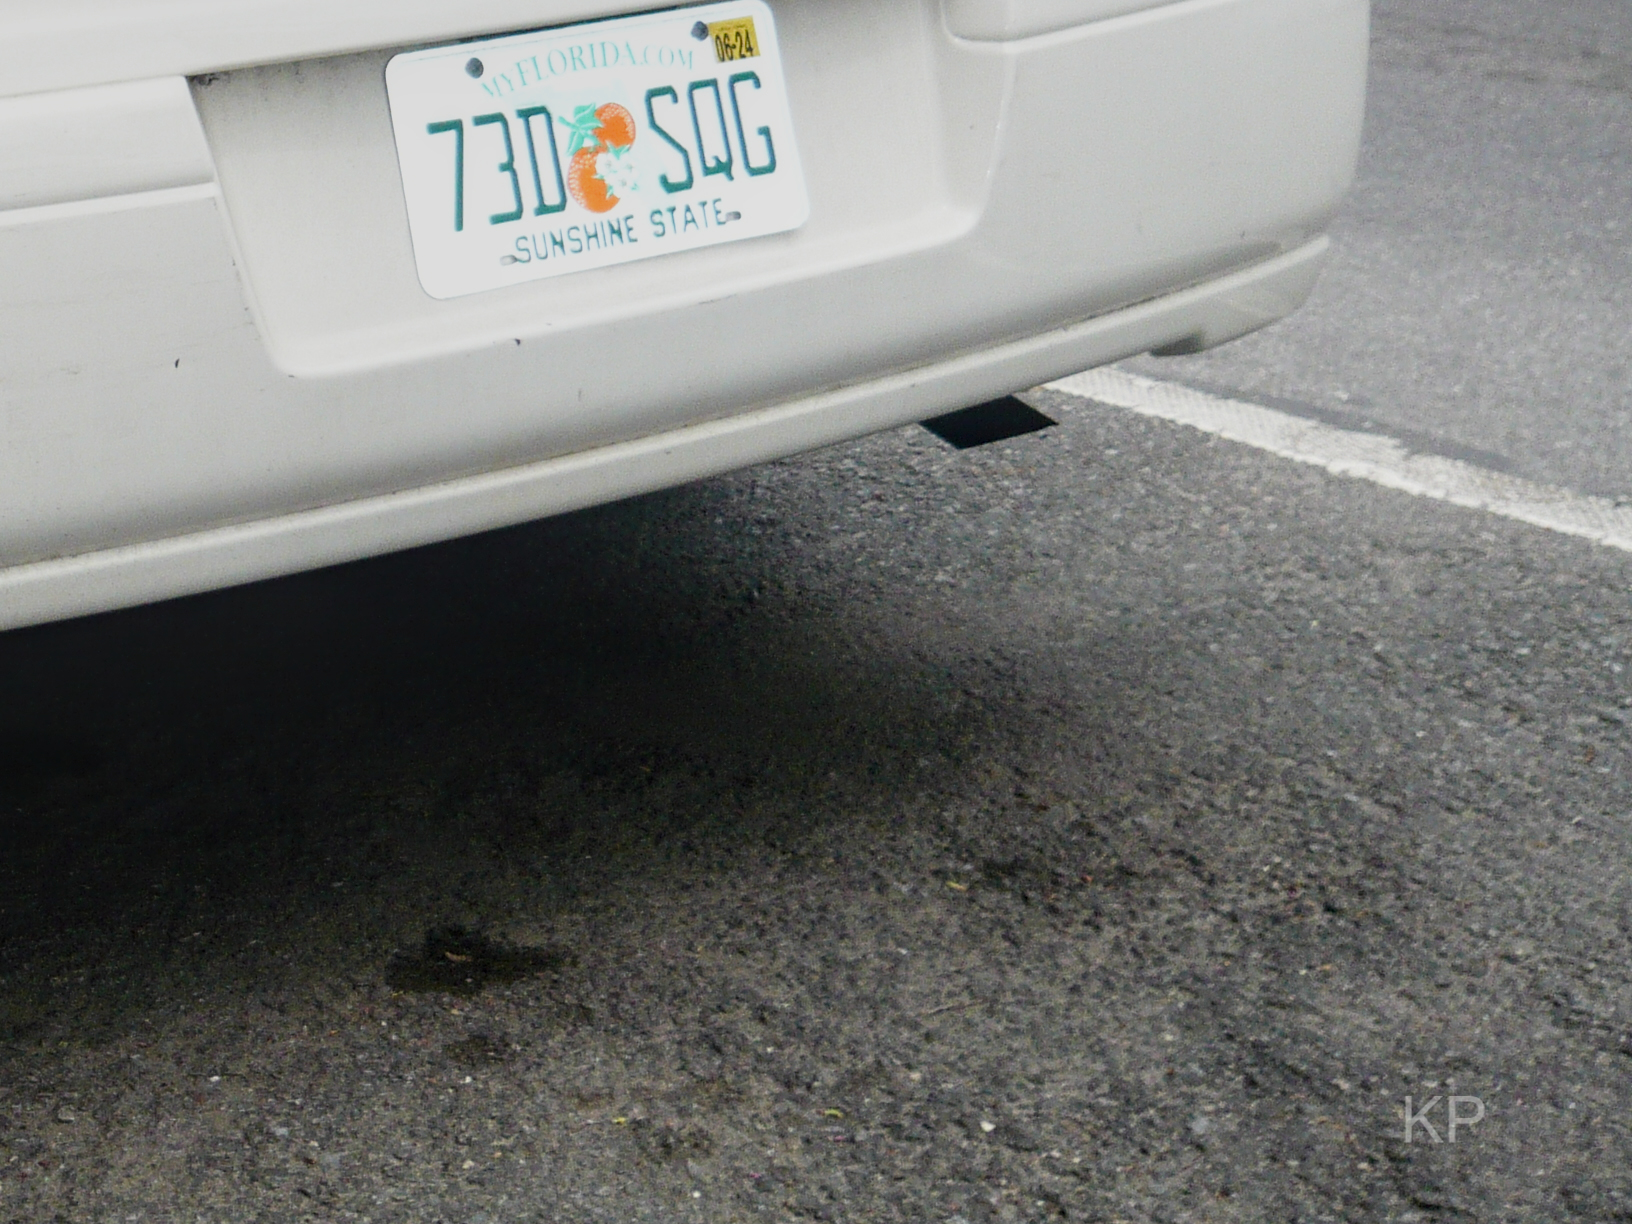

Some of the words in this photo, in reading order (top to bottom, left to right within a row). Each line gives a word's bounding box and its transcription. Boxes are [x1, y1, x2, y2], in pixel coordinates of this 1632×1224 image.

[480, 40, 694, 99] MYFLORIDA.COM
[715, 29, 754, 63] 06-24
[426, 105, 568, 232] 73D
[644, 70, 777, 194] SQG
[514, 215, 638, 264] SUNSHINE
[650, 198, 727, 237] STATE
